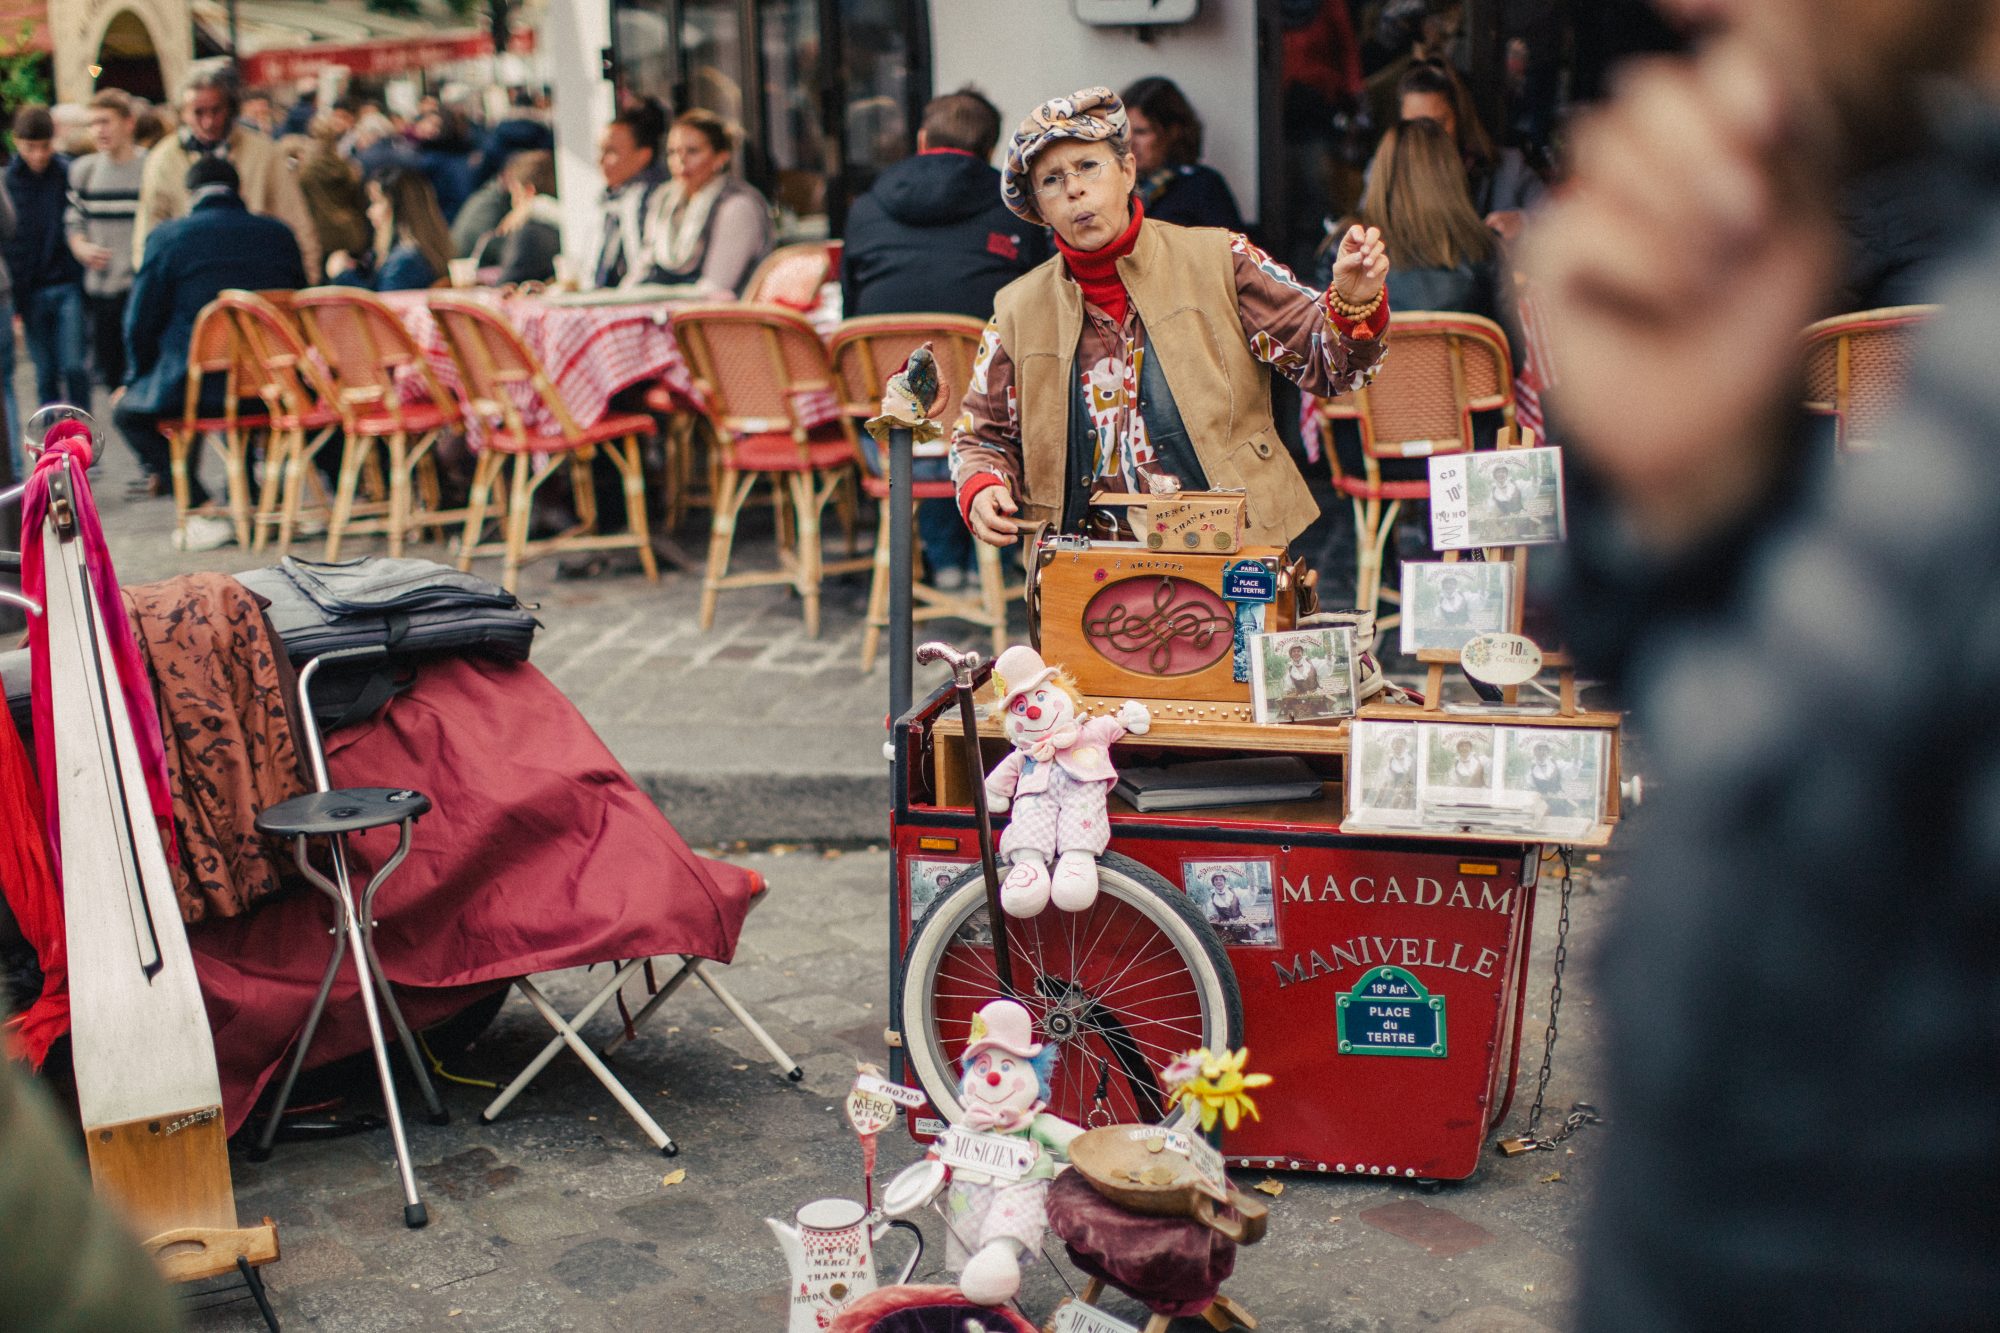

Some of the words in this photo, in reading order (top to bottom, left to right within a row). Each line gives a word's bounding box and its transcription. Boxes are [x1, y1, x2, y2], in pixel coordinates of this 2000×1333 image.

[1172, 513, 1206, 535] THANK
[1210, 507, 1231, 517] YOU
[1239, 579, 1259, 587] PLACE
[1243, 587, 1266, 595] TERTRE
[1280, 874, 1513, 916] MACADAM
[1271, 936, 1500, 989] MANIVELLE
[1369, 1006, 1411, 1017] PLACE
[1382, 1019, 1398, 1030] du
[1366, 1032, 1416, 1043] TERTRE
[878, 1084, 921, 1102] PHOTOS
[852, 1097, 893, 1115] MERCI
[853, 1109, 891, 1122] MERCI
[954, 1134, 1015, 1170] MUSICIEN
[814, 1258, 851, 1267] MERCI
[808, 1271, 847, 1282] THANK
[851, 1270, 868, 1280] YOU
